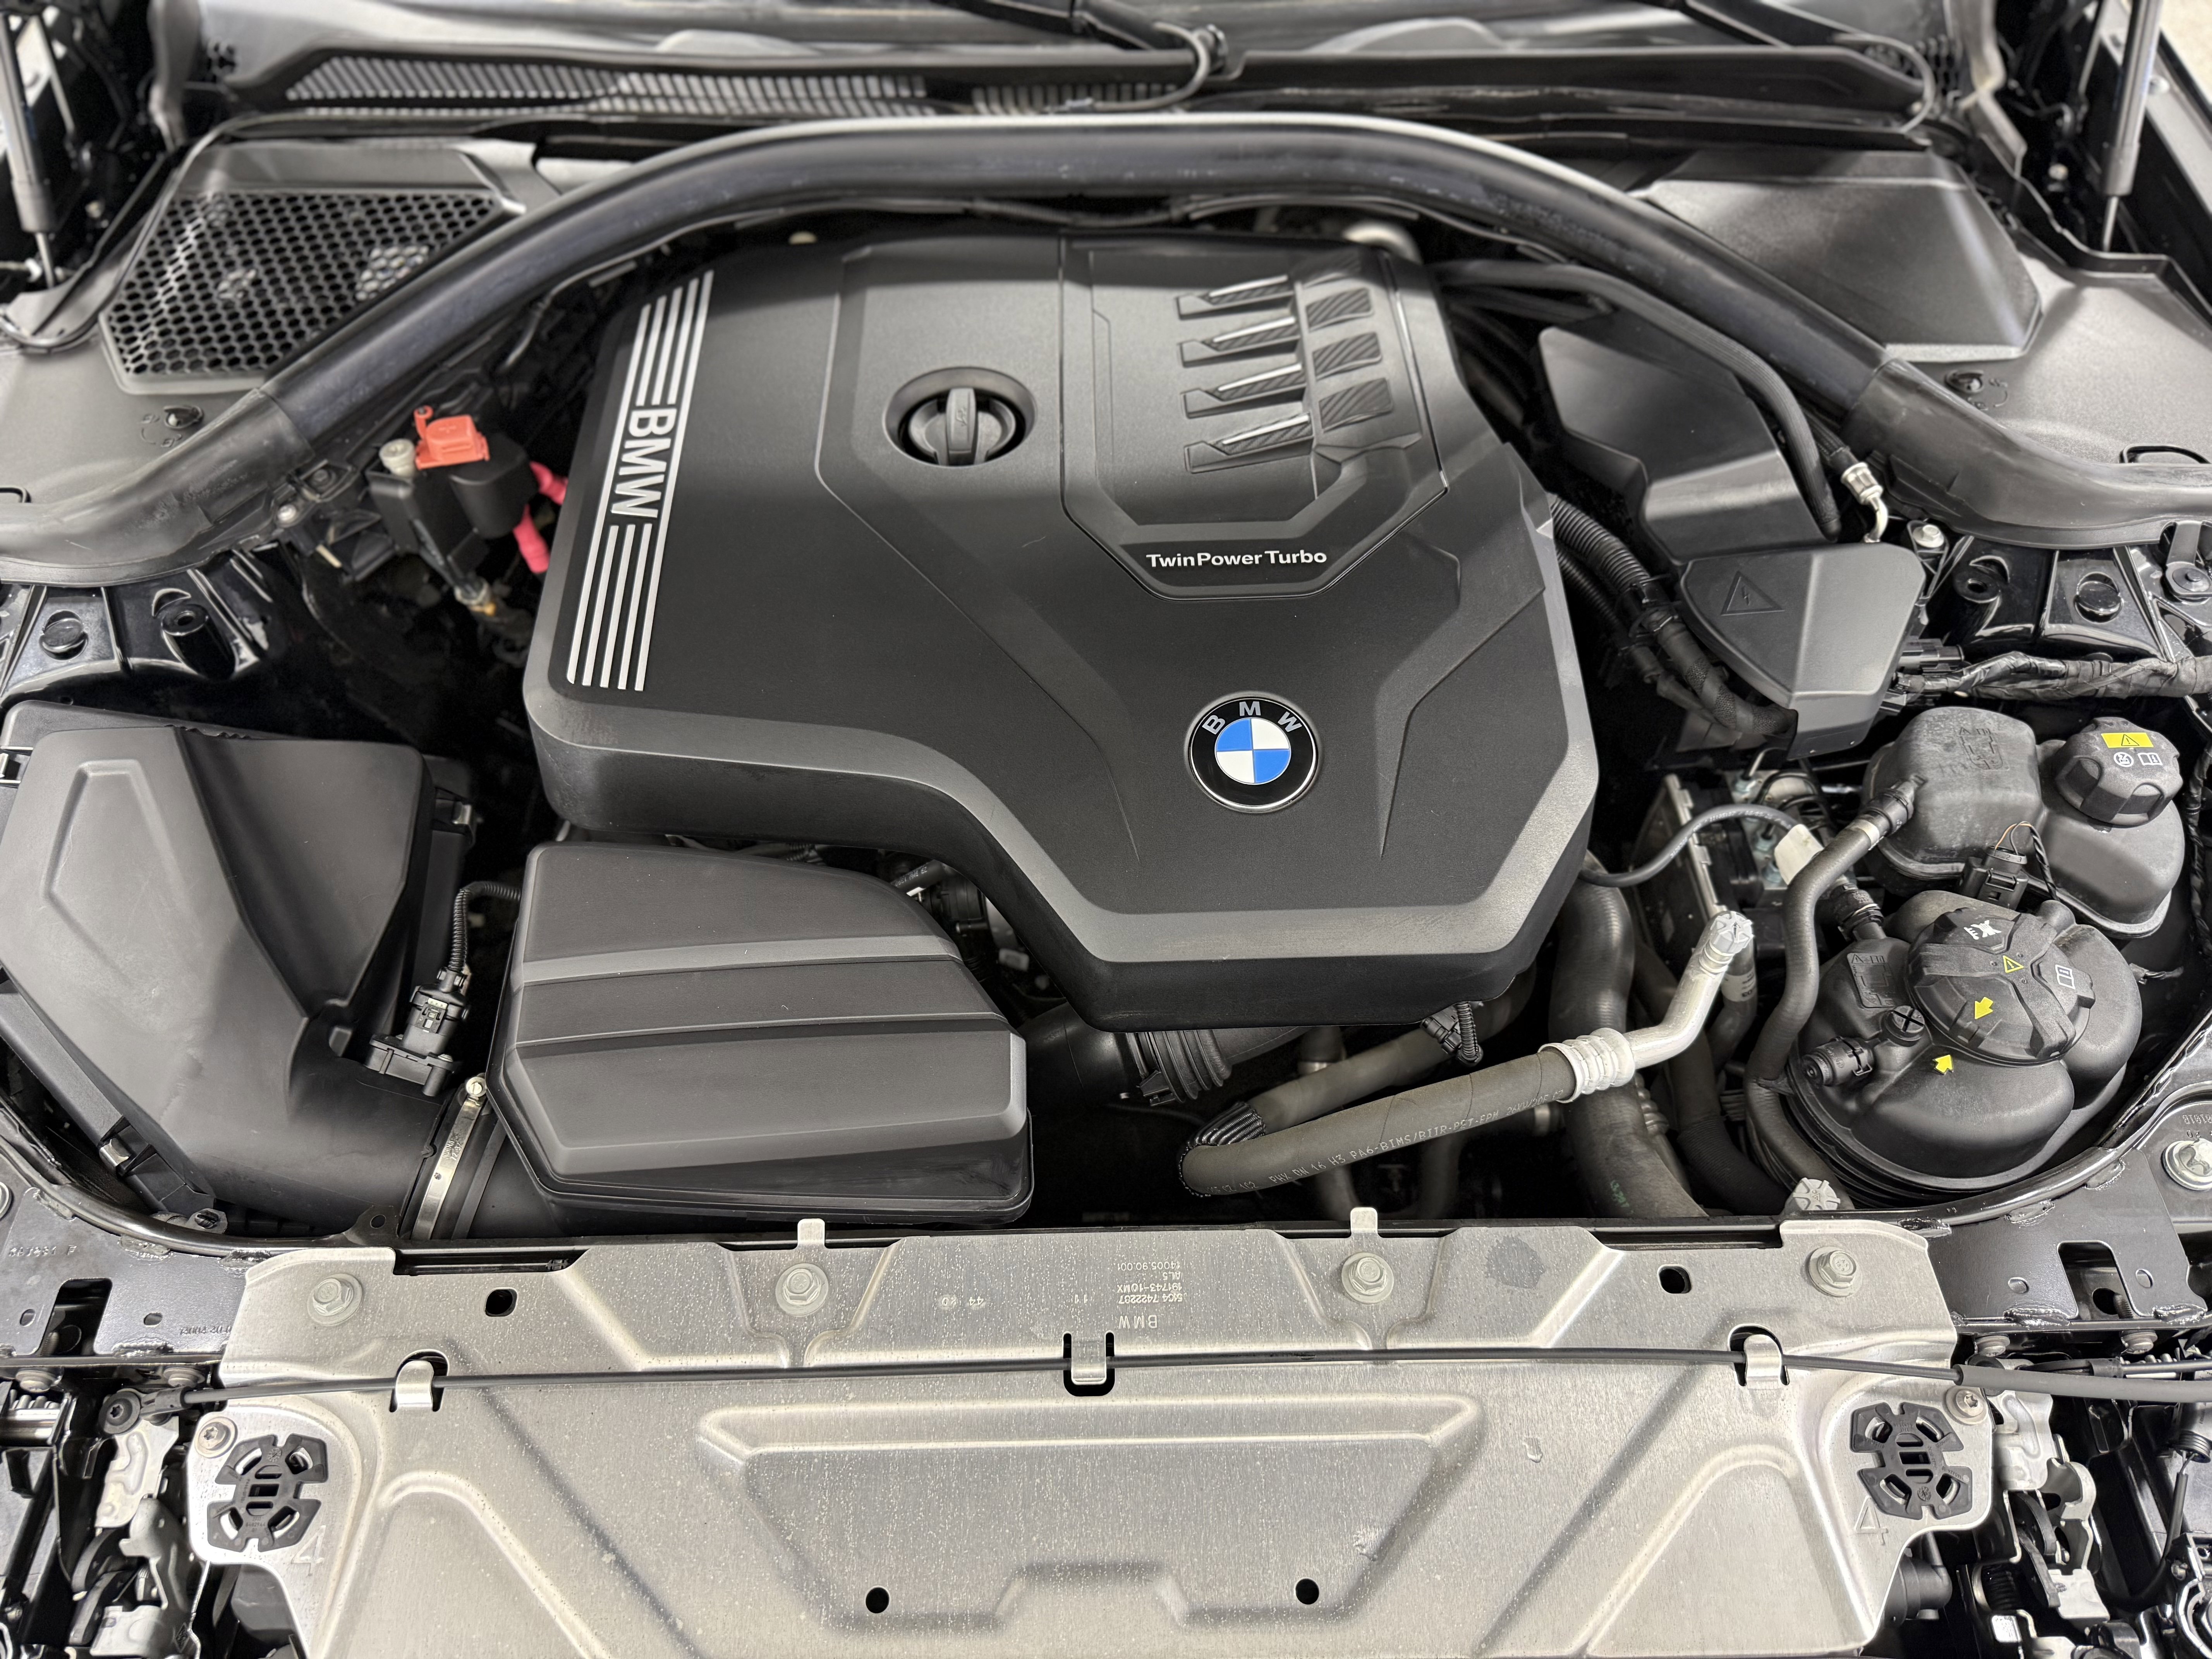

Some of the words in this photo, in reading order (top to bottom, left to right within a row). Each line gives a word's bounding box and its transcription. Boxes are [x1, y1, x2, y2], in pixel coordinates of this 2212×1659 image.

[610, 408, 677, 518] BMW
[1146, 551, 1262, 568] TwinPower
[1264, 550, 1327, 564] Turbo
[1202, 701, 1302, 735] BMW
[1293, 1166, 1310, 1178] DN
[1311, 1161, 1327, 1172] 16
[1329, 1153, 1346, 1166] H3
[1118, 1314, 1158, 1329] BMW
[1854, 1495, 1889, 1546] 4
[290, 1524, 327, 1577] 4
